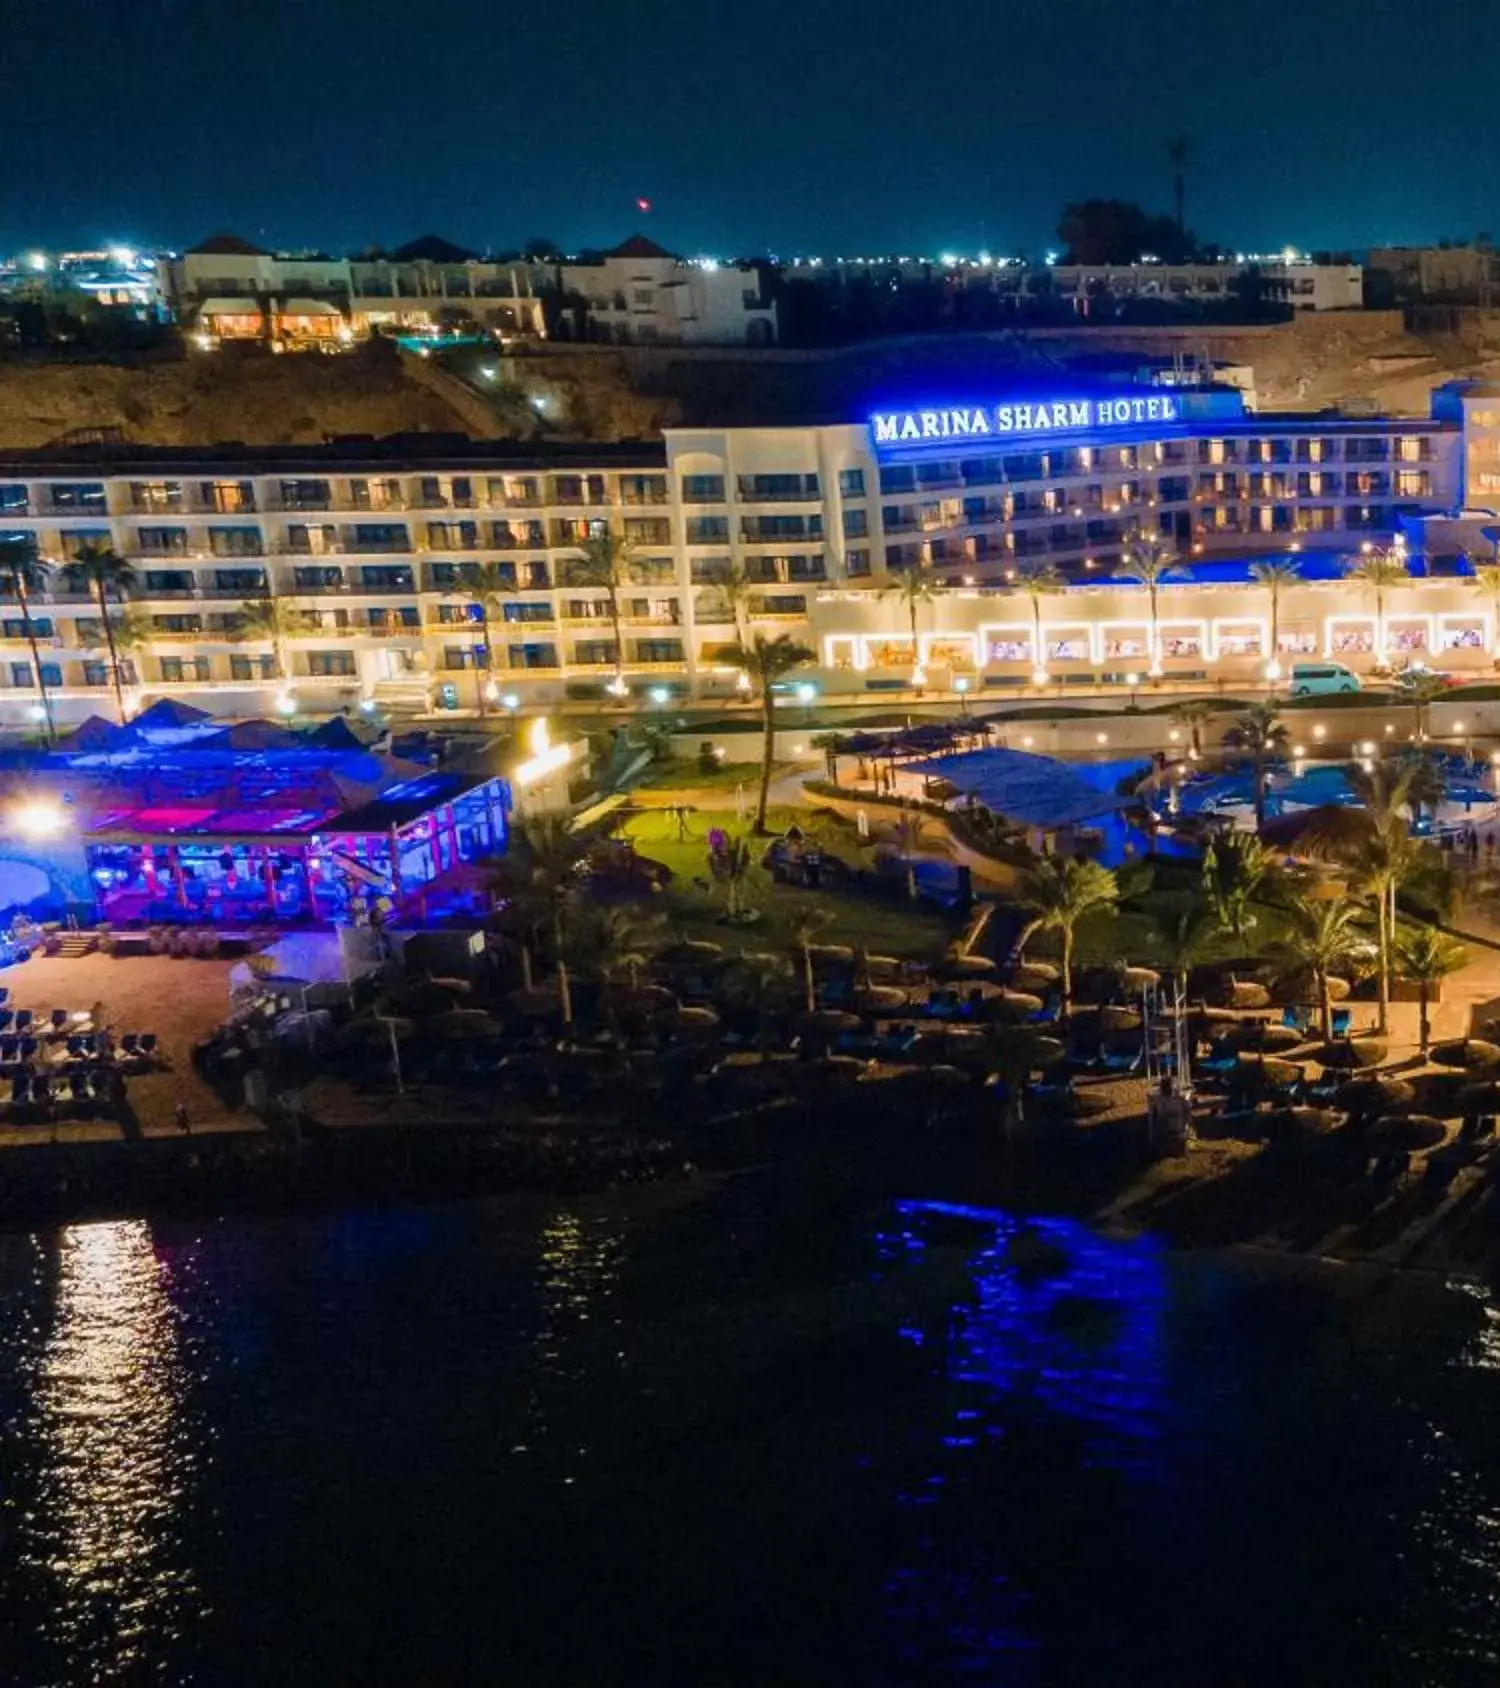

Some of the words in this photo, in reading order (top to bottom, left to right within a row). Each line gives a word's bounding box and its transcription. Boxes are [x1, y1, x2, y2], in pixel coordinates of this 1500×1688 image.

[875, 409, 989, 442] MARINA
[1000, 401, 1089, 431] SHARM
[1099, 397, 1175, 424] HOTEL
